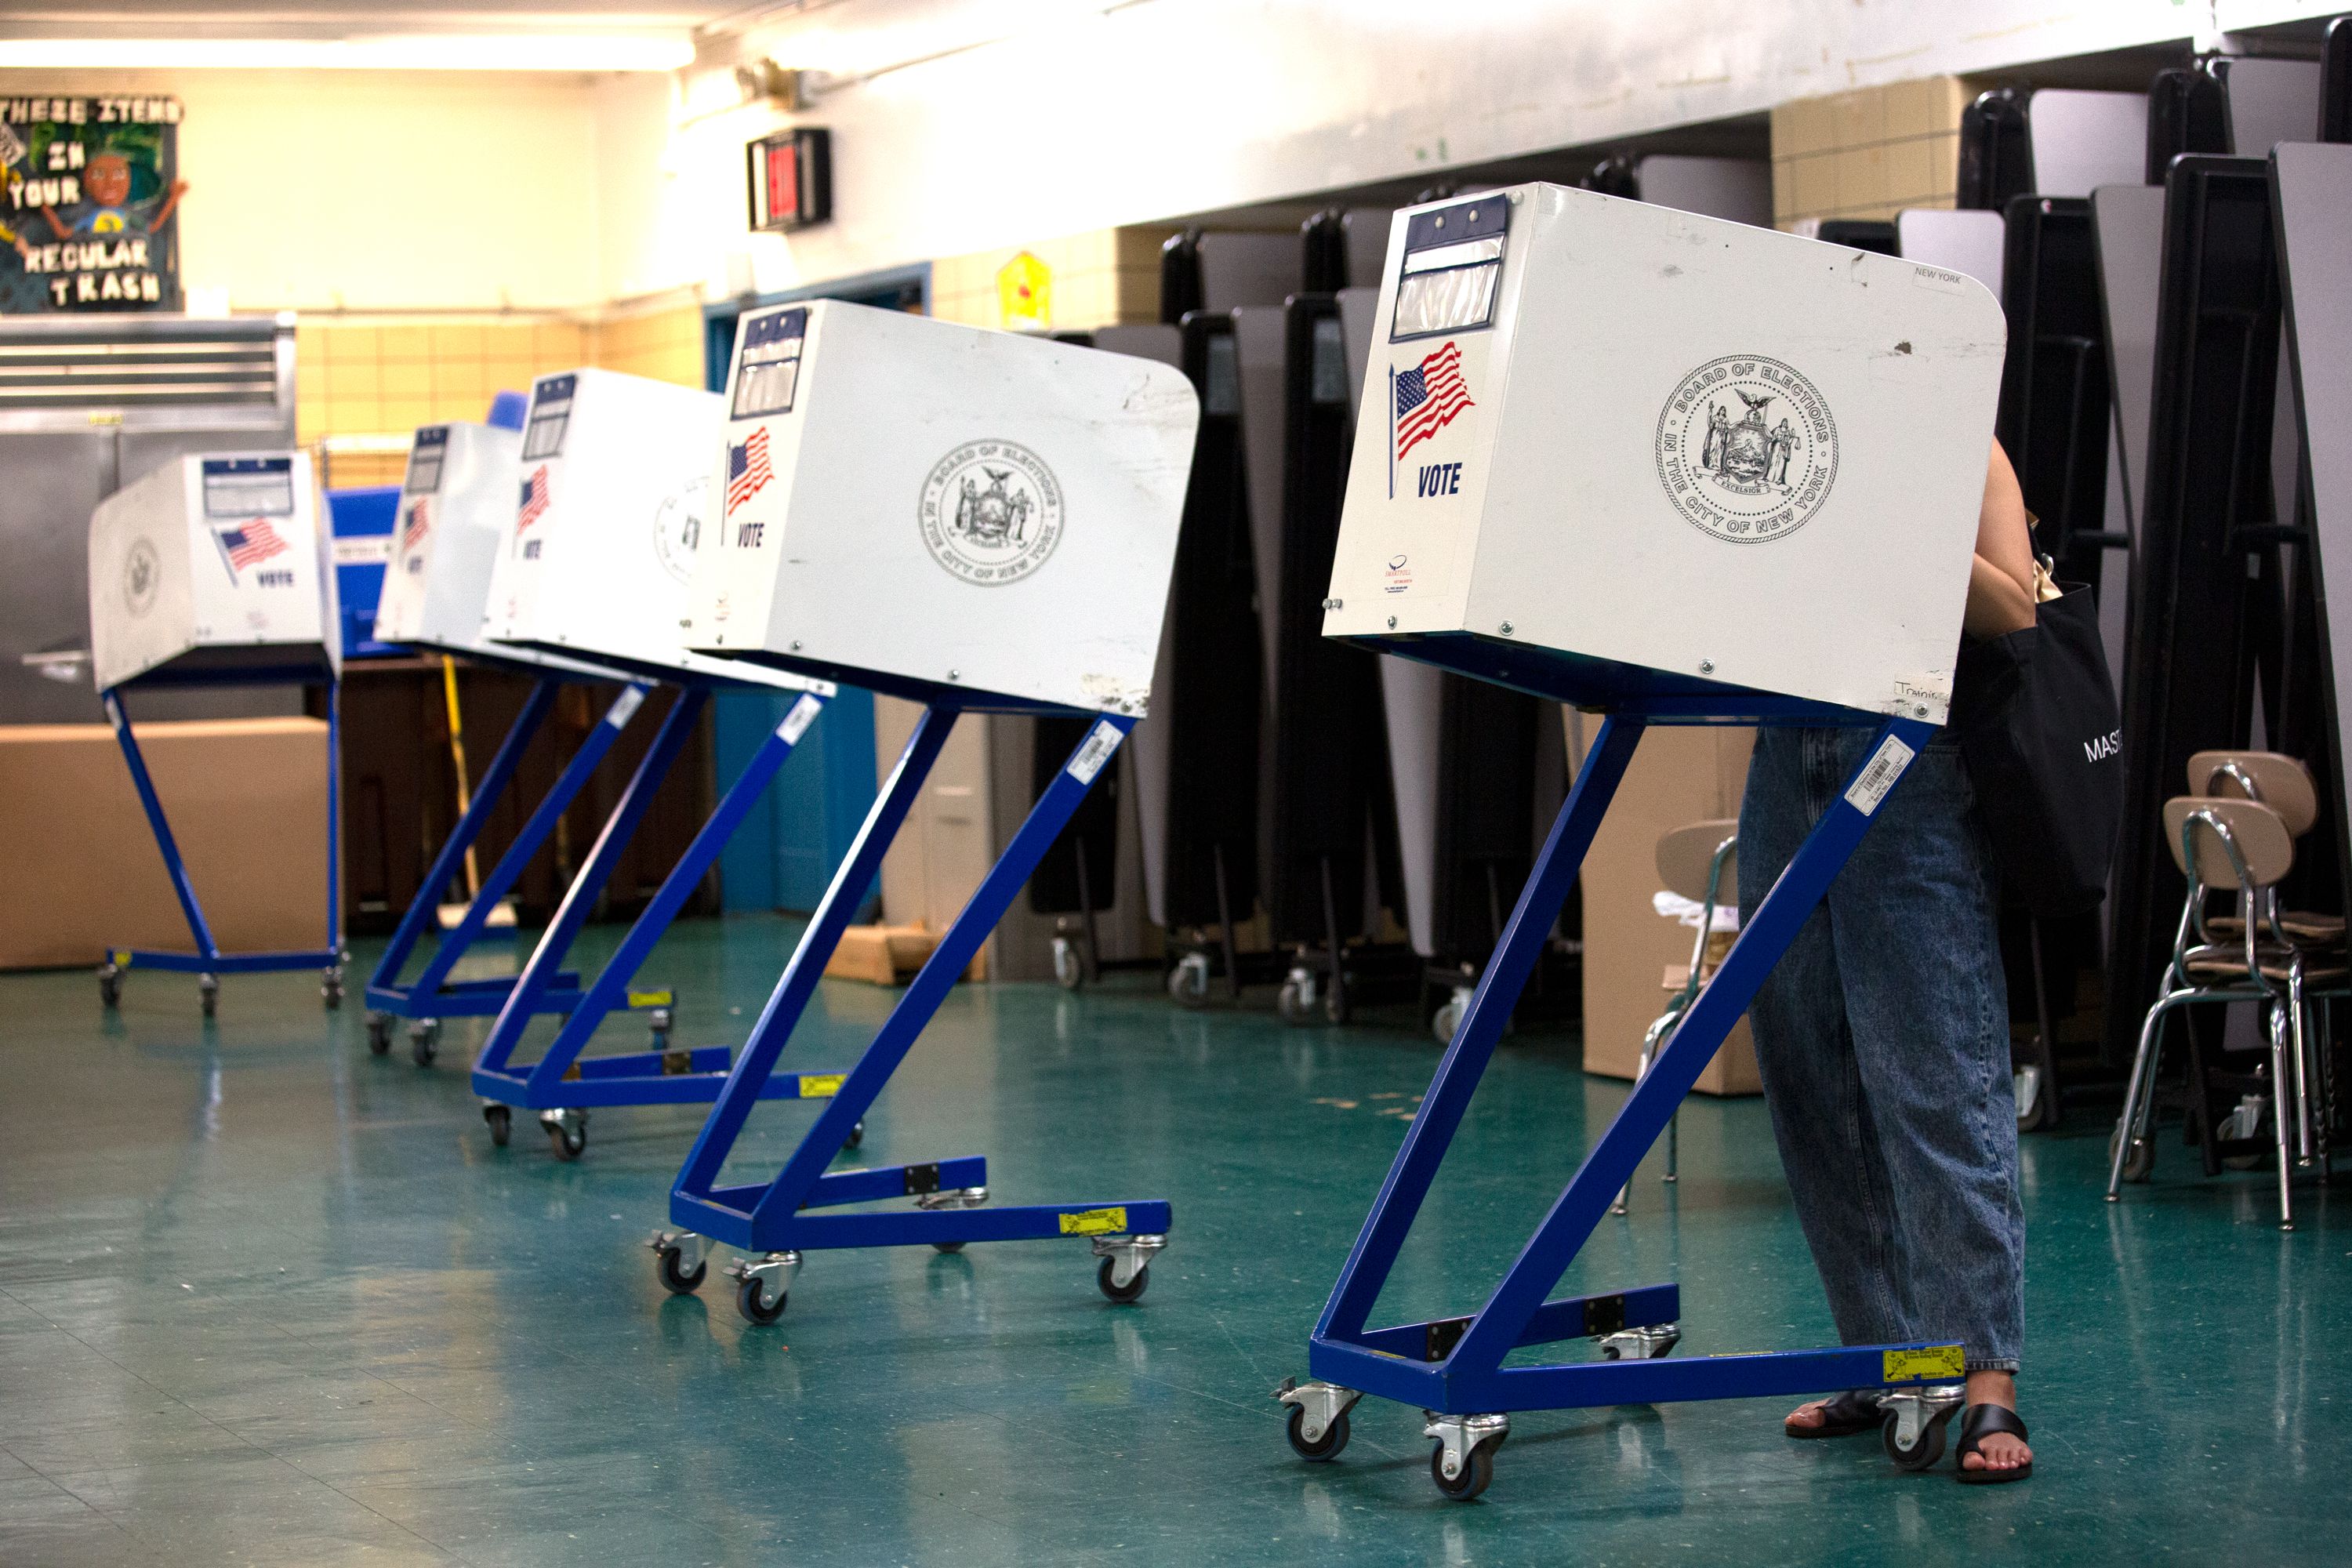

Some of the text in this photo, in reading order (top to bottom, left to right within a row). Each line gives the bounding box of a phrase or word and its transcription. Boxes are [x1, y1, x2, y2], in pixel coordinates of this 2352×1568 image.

[98, 100, 180, 123] ITEMS
[49, 141, 85, 170] IN
[8, 176, 81, 210] YOUR
[25, 239, 149, 273] REGULAR
[1915, 267, 1962, 284] NEW YORK
[1675, 364, 1828, 443] BOARD OF ELECTIONS
[935, 446, 1056, 506] BOARD OF ELECTIONS
[1418, 463, 1462, 497] VOTE
[1664, 433, 1828, 533] IN THE CITY OF NEW YORK
[1721, 481, 1762, 494] EXCELSIOR
[738, 522, 764, 547] VOTE
[924, 501, 1055, 579] IN THE CITY OF NEW YORK
[256, 569, 294, 587] VOTE
